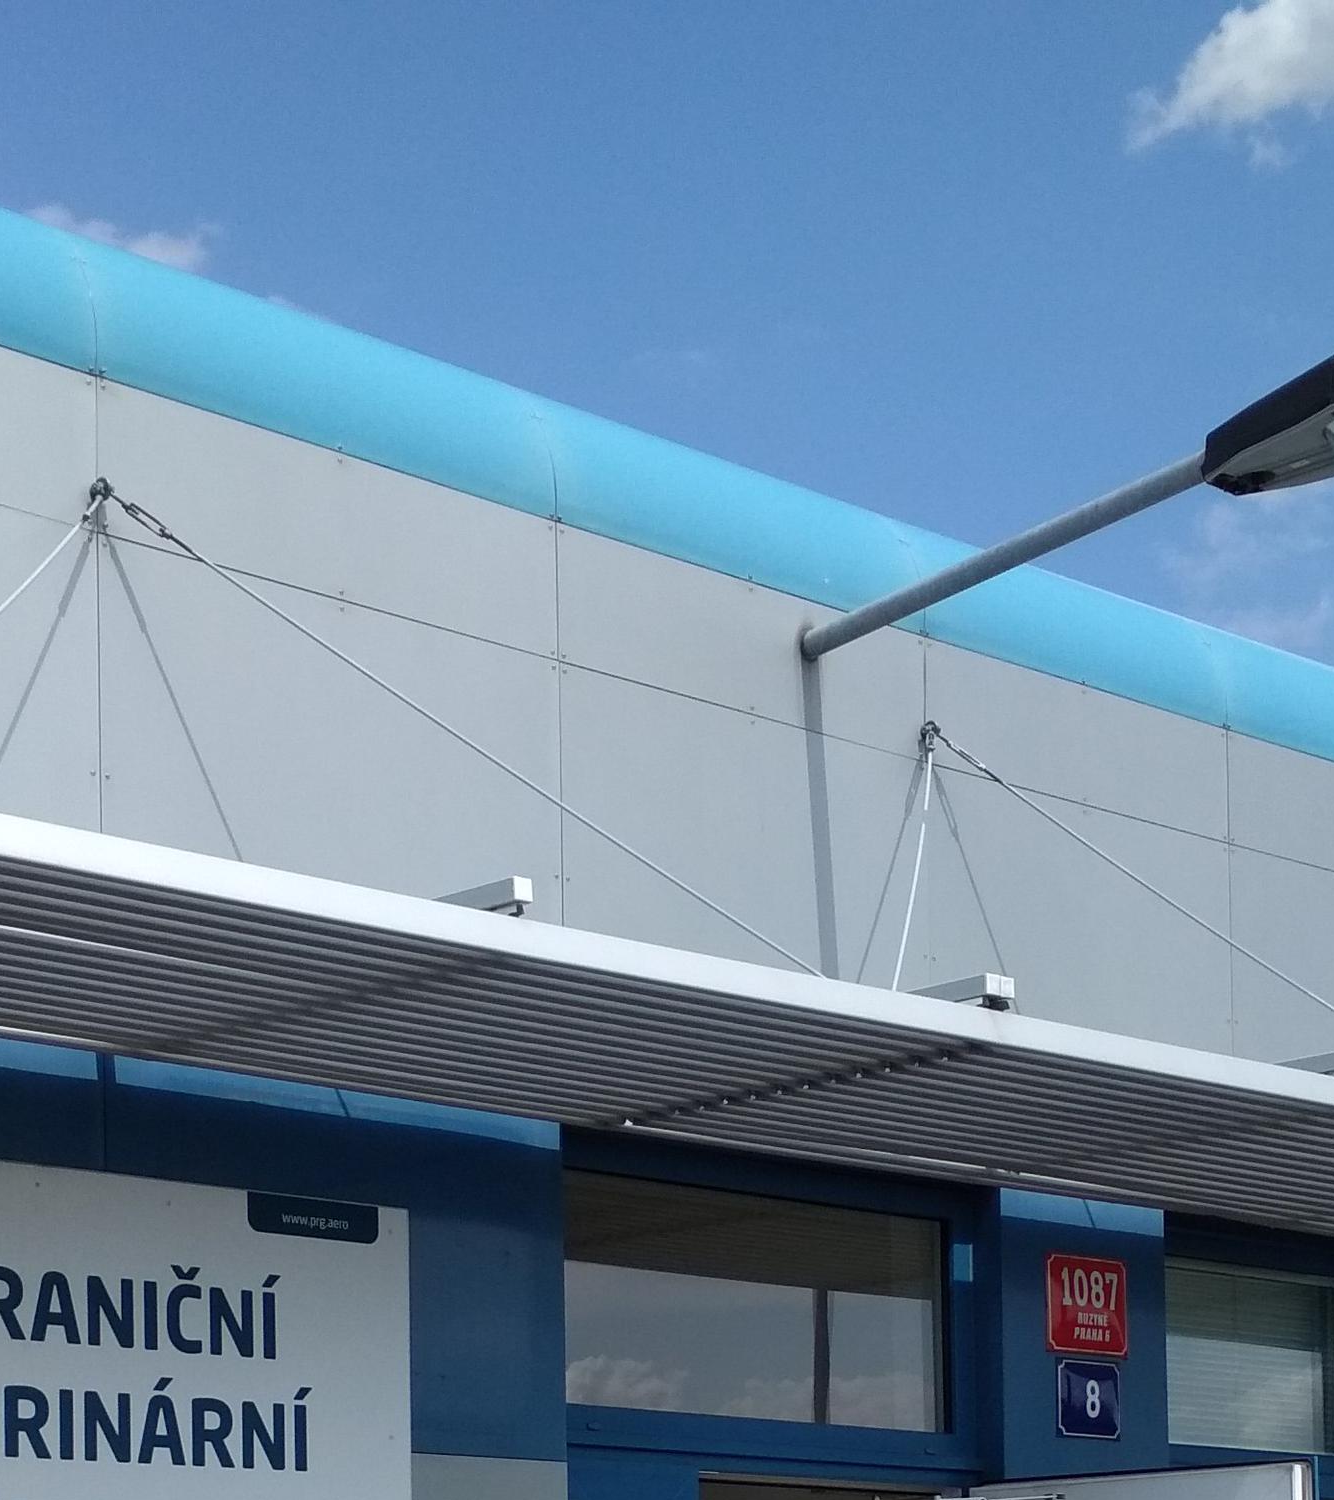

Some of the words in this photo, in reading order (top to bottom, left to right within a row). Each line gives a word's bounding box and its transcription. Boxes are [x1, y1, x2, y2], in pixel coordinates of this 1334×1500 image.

[281, 1213, 349, 1231] www.prg.aero
[1061, 1266, 1118, 1311] 1087
[1074, 1326, 1103, 1341] PRAHA
[1085, 1379, 1101, 1418] 8
